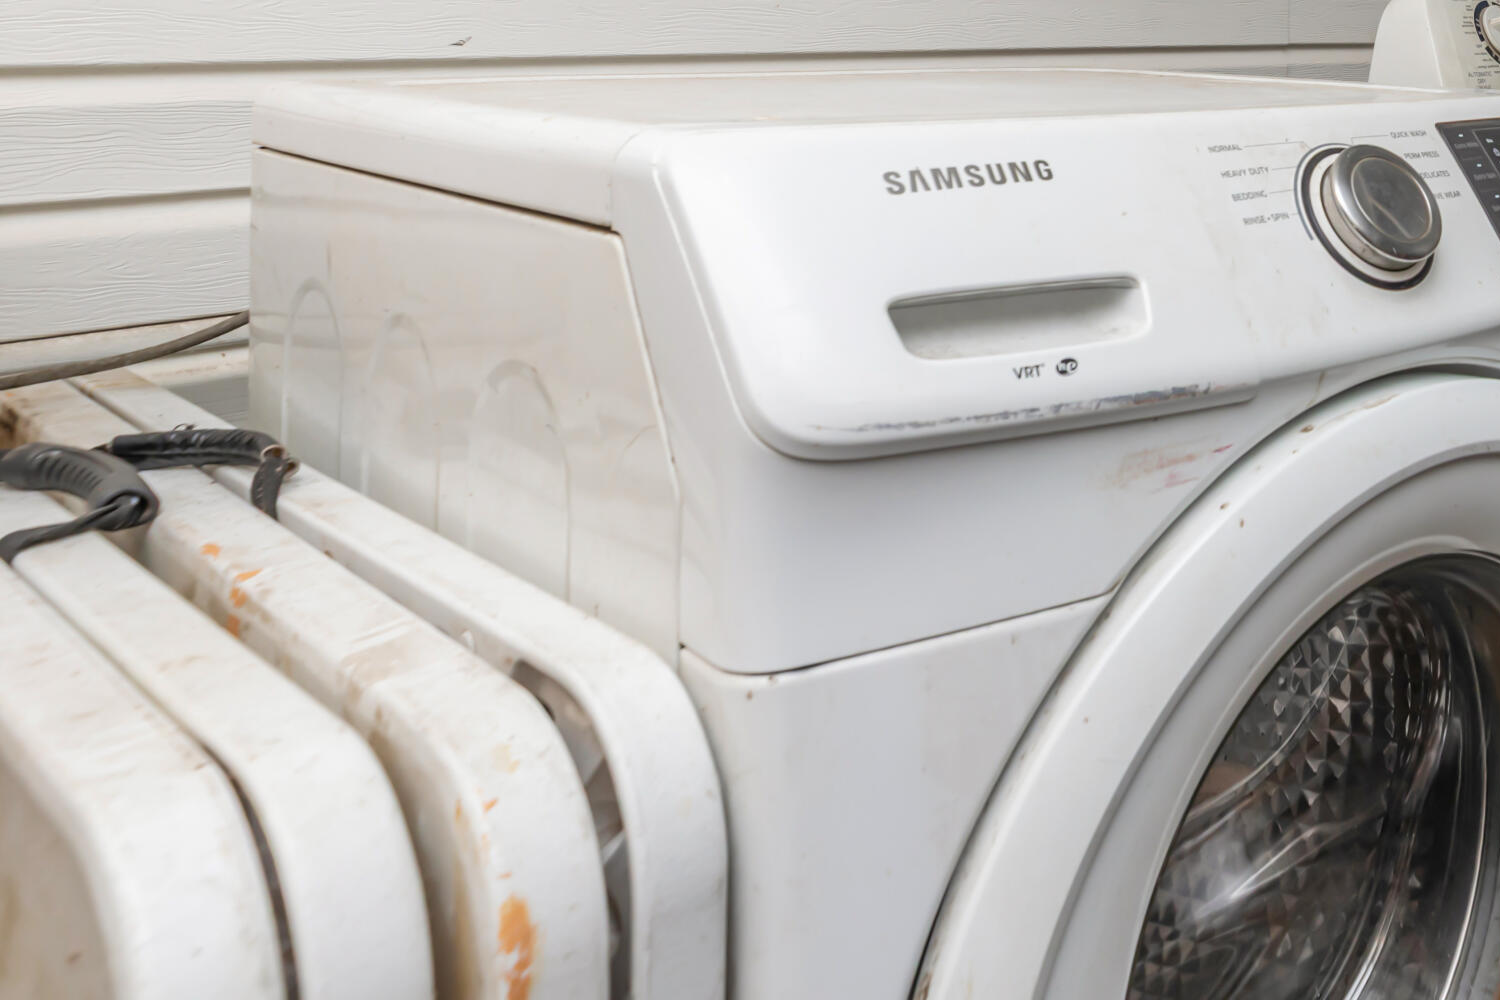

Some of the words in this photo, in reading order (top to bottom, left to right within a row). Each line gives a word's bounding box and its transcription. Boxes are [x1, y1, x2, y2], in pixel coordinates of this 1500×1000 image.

[1207, 144, 1243, 153] NORMAL
[1403, 152, 1420, 160] PERM
[1421, 150, 1440, 159] PRESS
[882, 159, 1054, 196] SAMSUNG
[1220, 168, 1247, 178] HEAVY
[1248, 166, 1269, 176] DUTY
[1232, 190, 1268, 202] BEDDING
